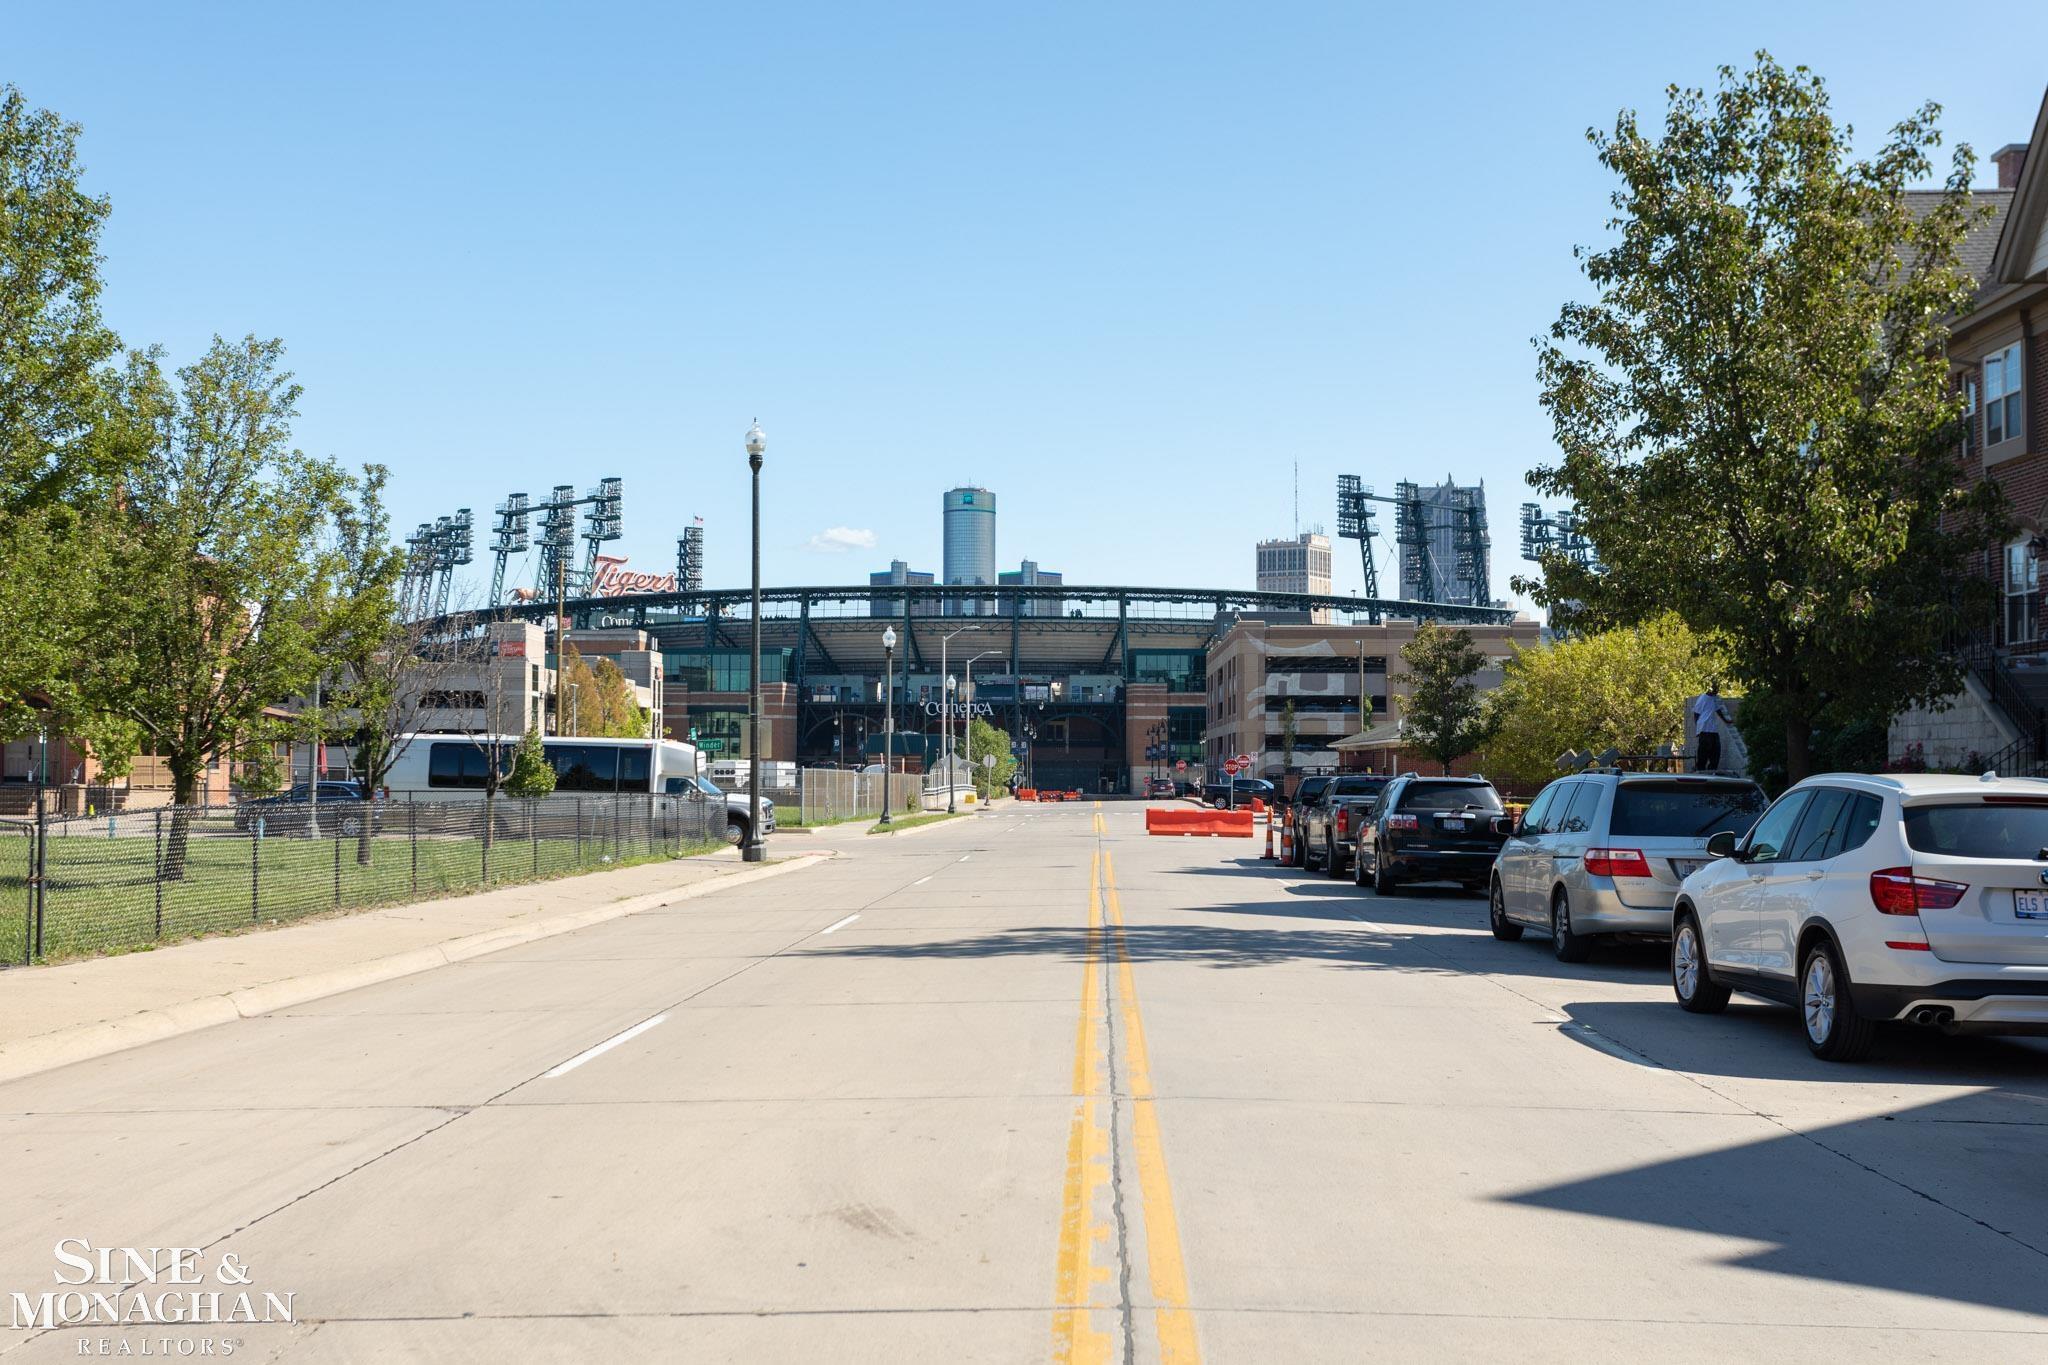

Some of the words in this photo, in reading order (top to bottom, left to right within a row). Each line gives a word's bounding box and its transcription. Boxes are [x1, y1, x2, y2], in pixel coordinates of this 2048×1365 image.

[591, 555, 677, 597] Tigers
[1225, 763, 1238, 771] STOP
[2018, 897, 2038, 911] ELS
